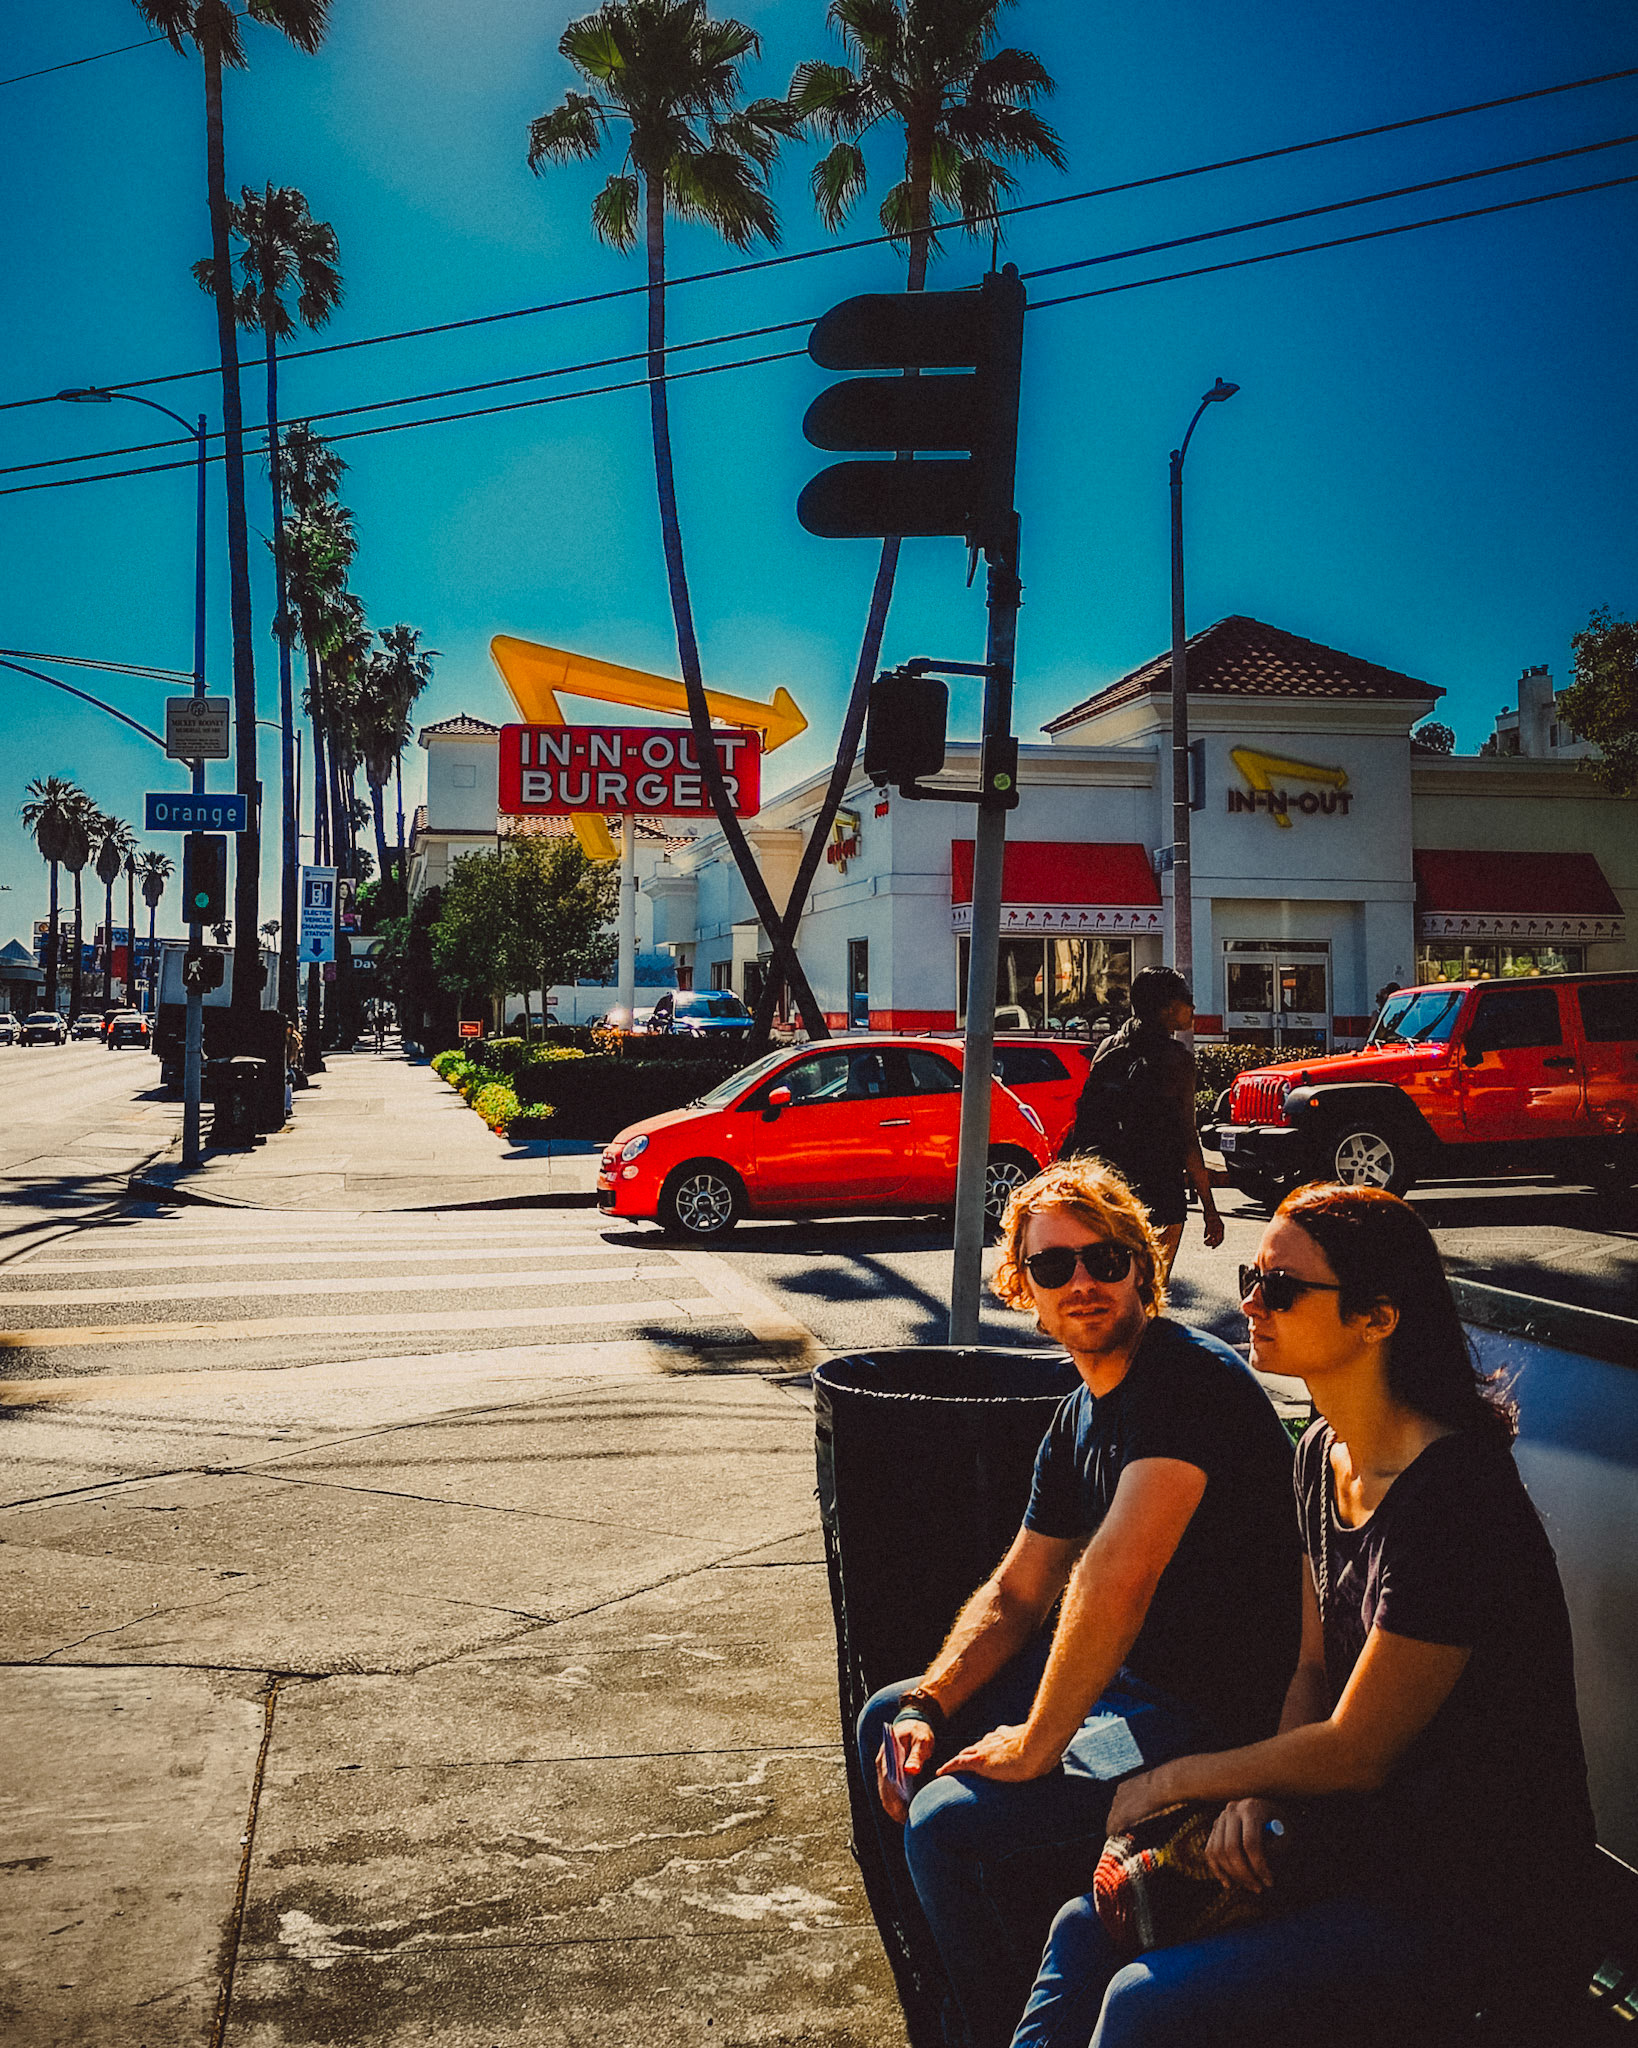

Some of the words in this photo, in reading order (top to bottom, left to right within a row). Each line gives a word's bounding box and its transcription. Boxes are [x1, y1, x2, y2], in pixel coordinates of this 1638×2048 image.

[522, 770, 740, 808] BURGER
[1228, 788, 1354, 815] IN-N-OUT
[155, 803, 238, 828] Orange
